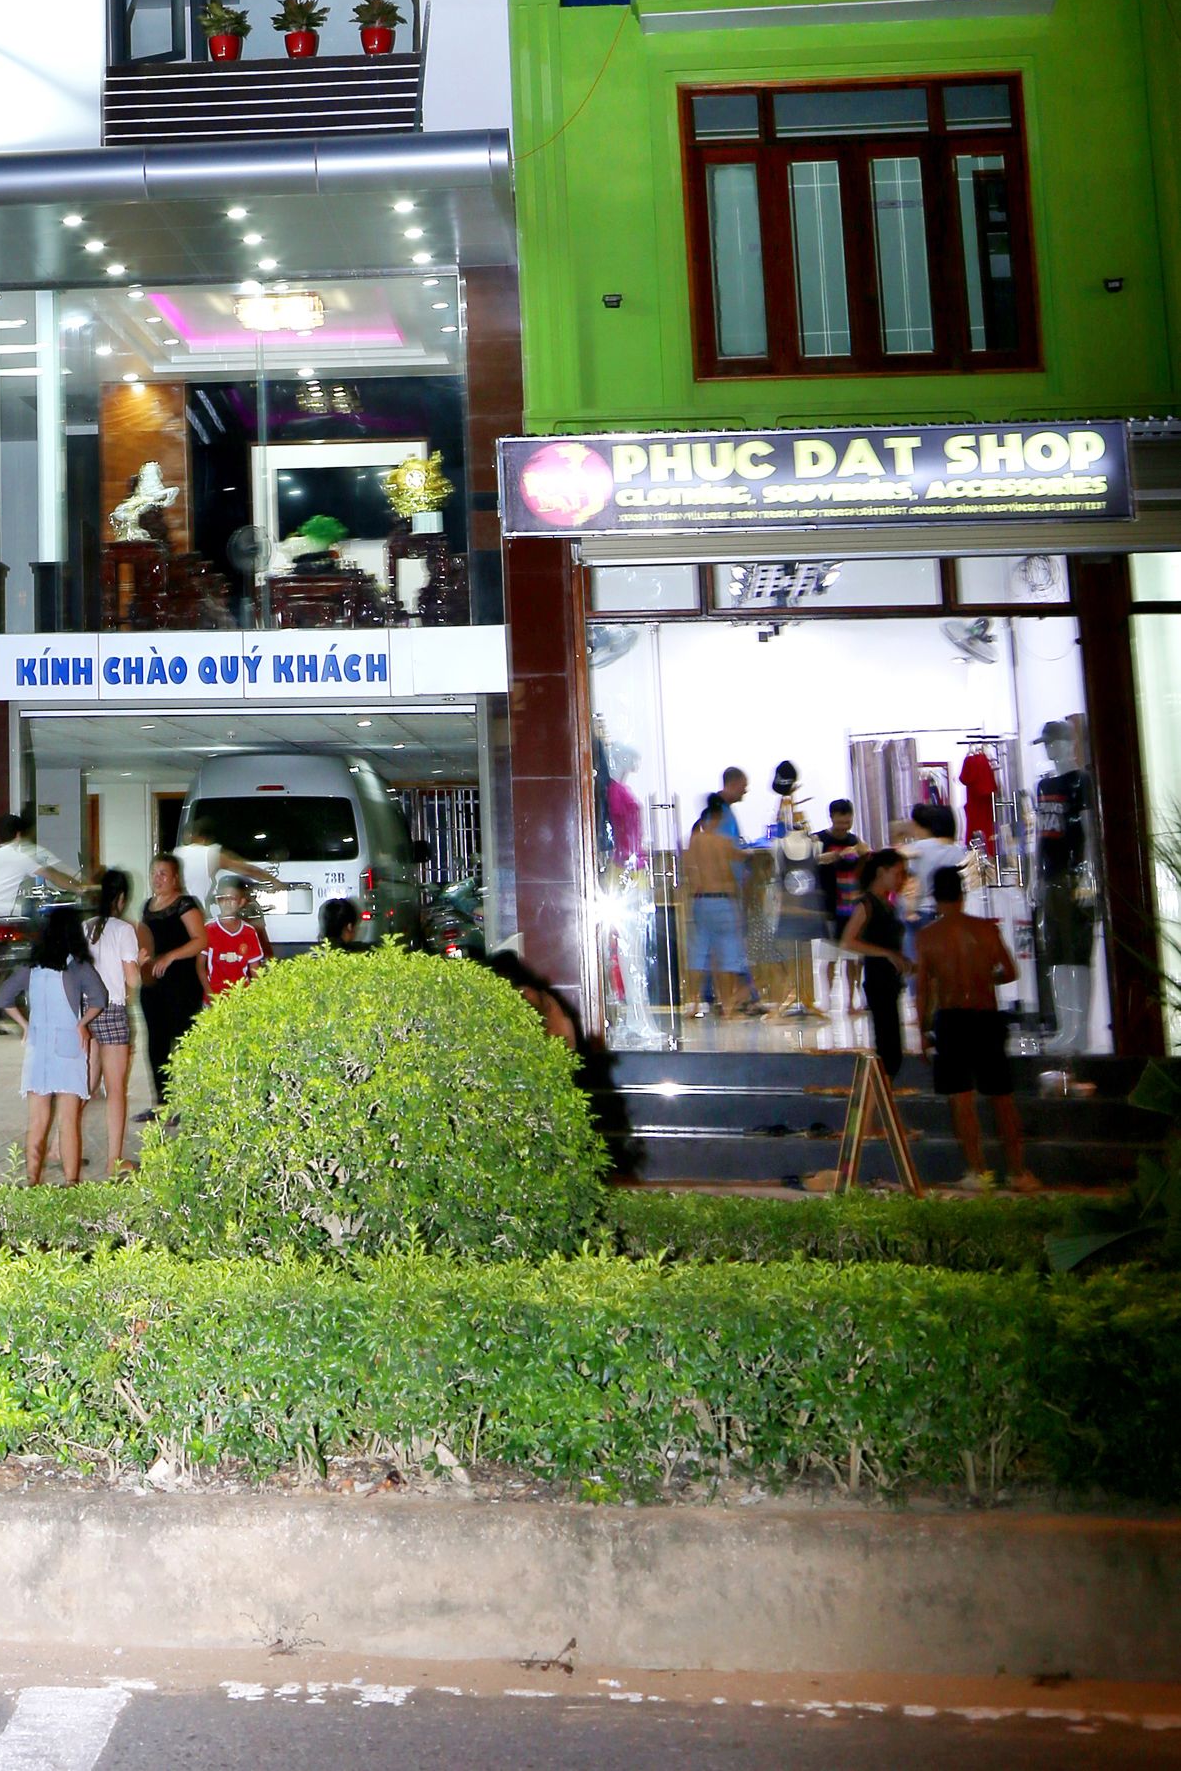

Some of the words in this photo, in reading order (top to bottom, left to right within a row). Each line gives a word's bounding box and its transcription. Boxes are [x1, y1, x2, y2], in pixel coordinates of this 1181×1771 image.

[612, 440, 777, 484] PHUC
[793, 436, 921, 479] DAT
[943, 430, 1107, 475] SHOP
[16, 647, 93, 686] KÍNH
[103, 646, 188, 685] CHÀO
[198, 645, 262, 684] QUÝ
[272, 643, 388, 683] KHÁCH
